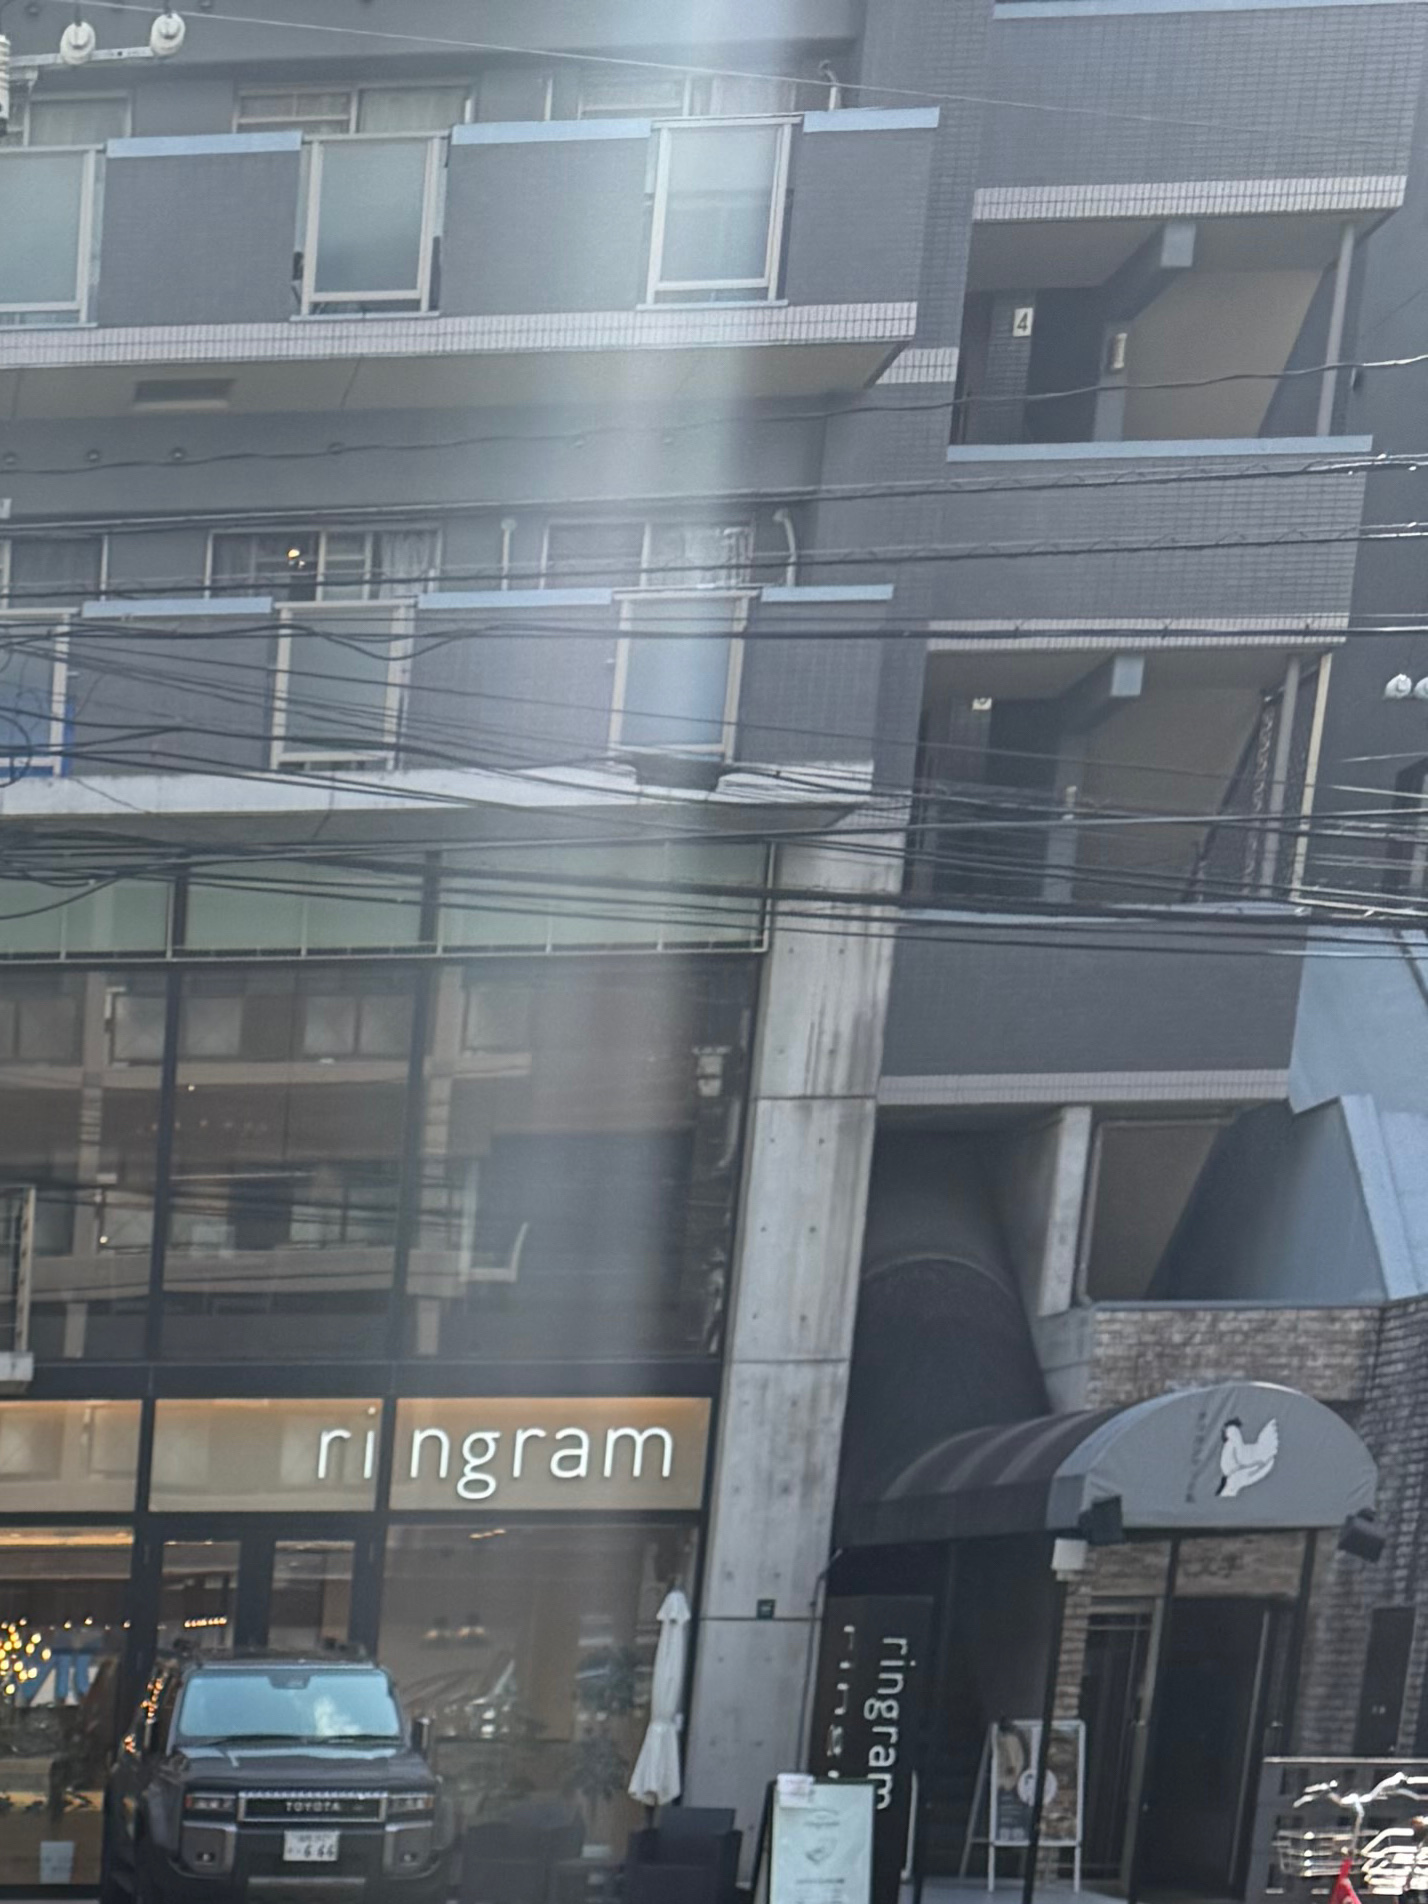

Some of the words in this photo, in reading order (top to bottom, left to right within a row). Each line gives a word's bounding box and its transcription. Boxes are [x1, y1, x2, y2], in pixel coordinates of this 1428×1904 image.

[1017, 311, 1028, 331] 4
[318, 1406, 673, 1499] ringram
[864, 1637, 916, 1810] ringram
[286, 1801, 340, 1812] TOYOTA
